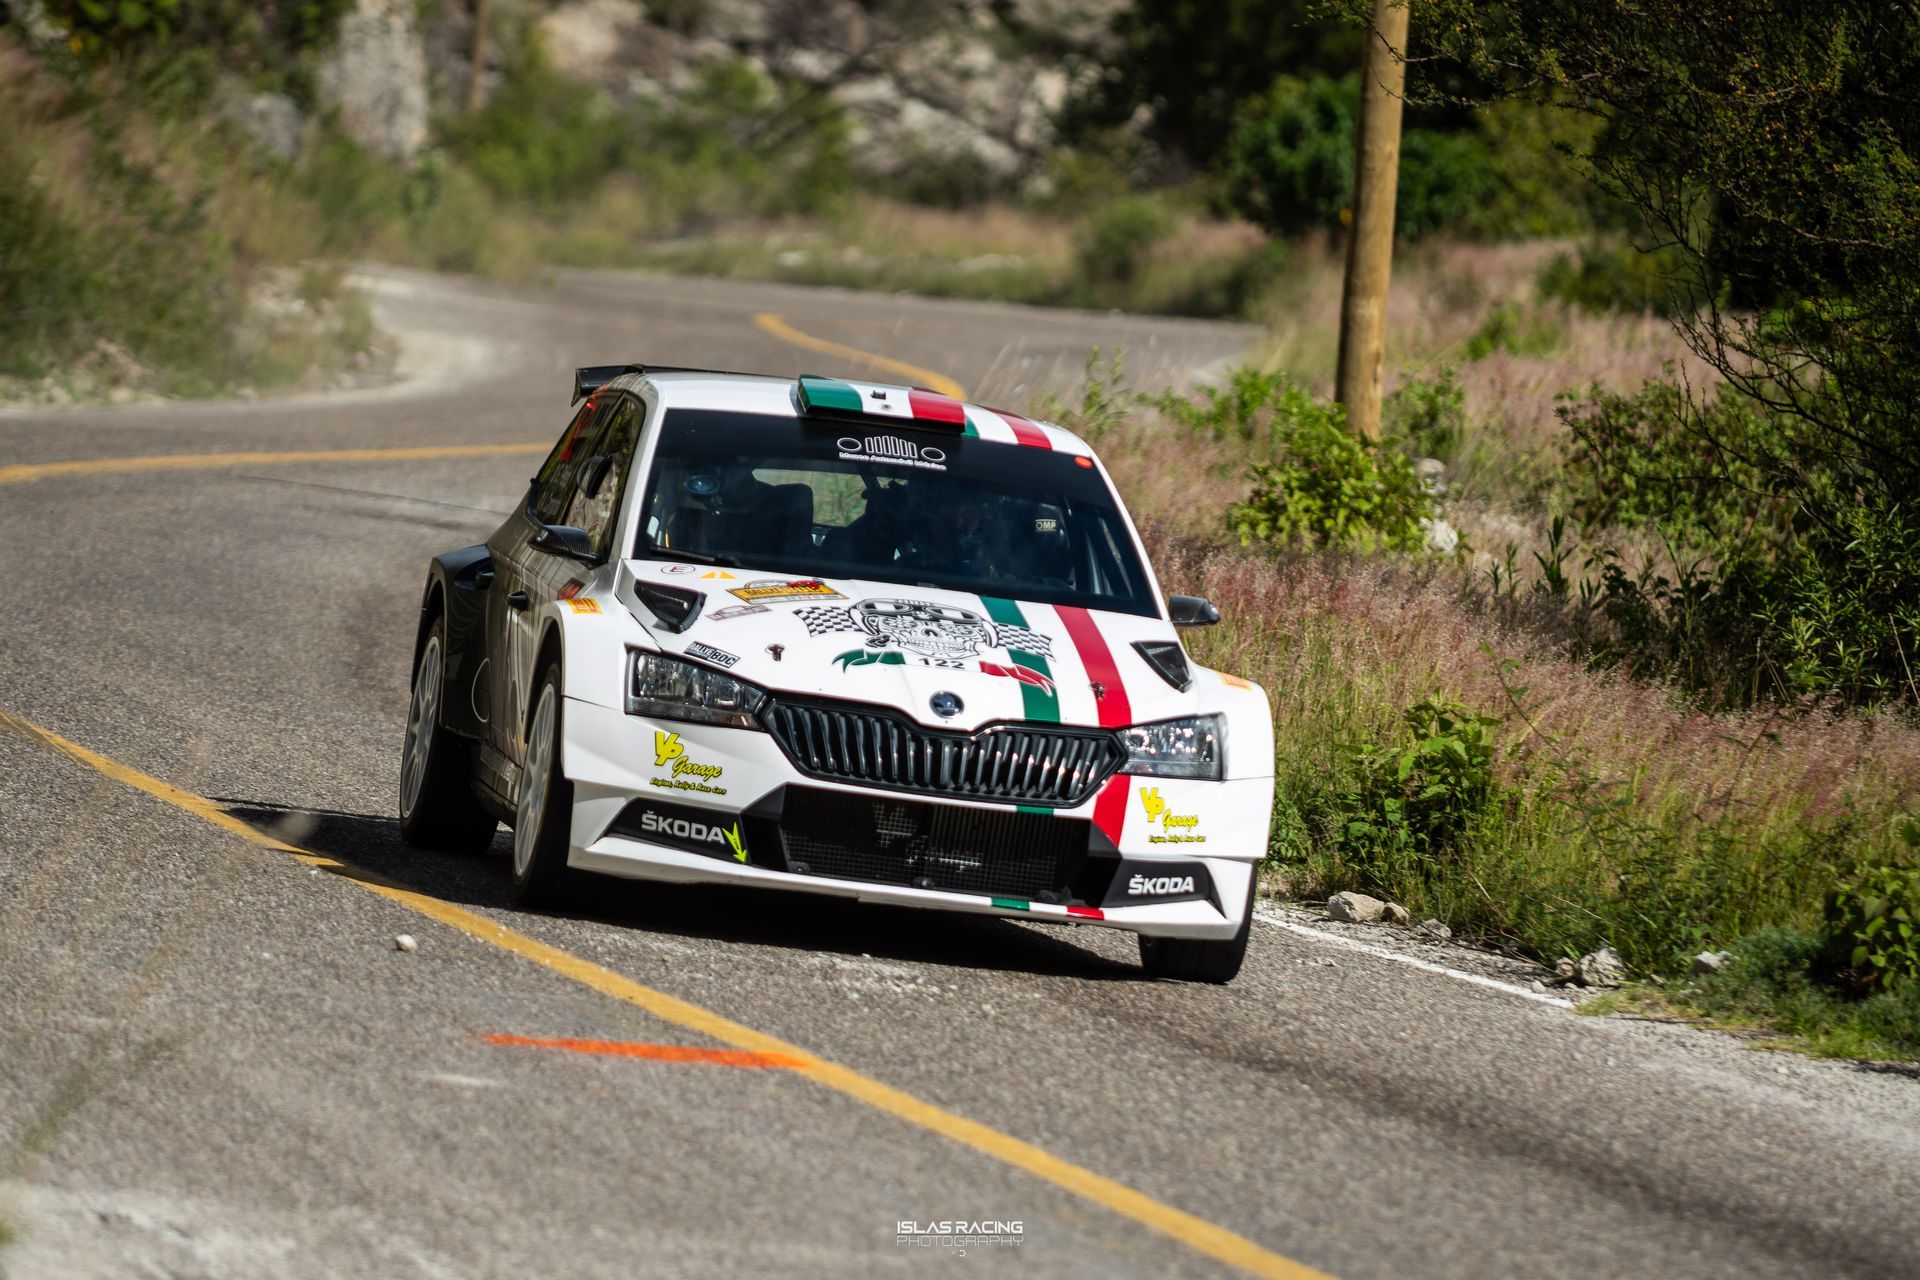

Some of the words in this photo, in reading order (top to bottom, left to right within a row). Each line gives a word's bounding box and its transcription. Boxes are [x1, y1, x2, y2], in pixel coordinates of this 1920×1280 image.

[1036, 521, 1056, 530] OMP
[688, 643, 715, 657] RALLYE
[919, 658, 966, 670] 122
[672, 755, 723, 782] Garage
[641, 810, 726, 845] ŠKODA
[1162, 809, 1198, 832] Garage
[1128, 874, 1194, 895] ŠKODA
